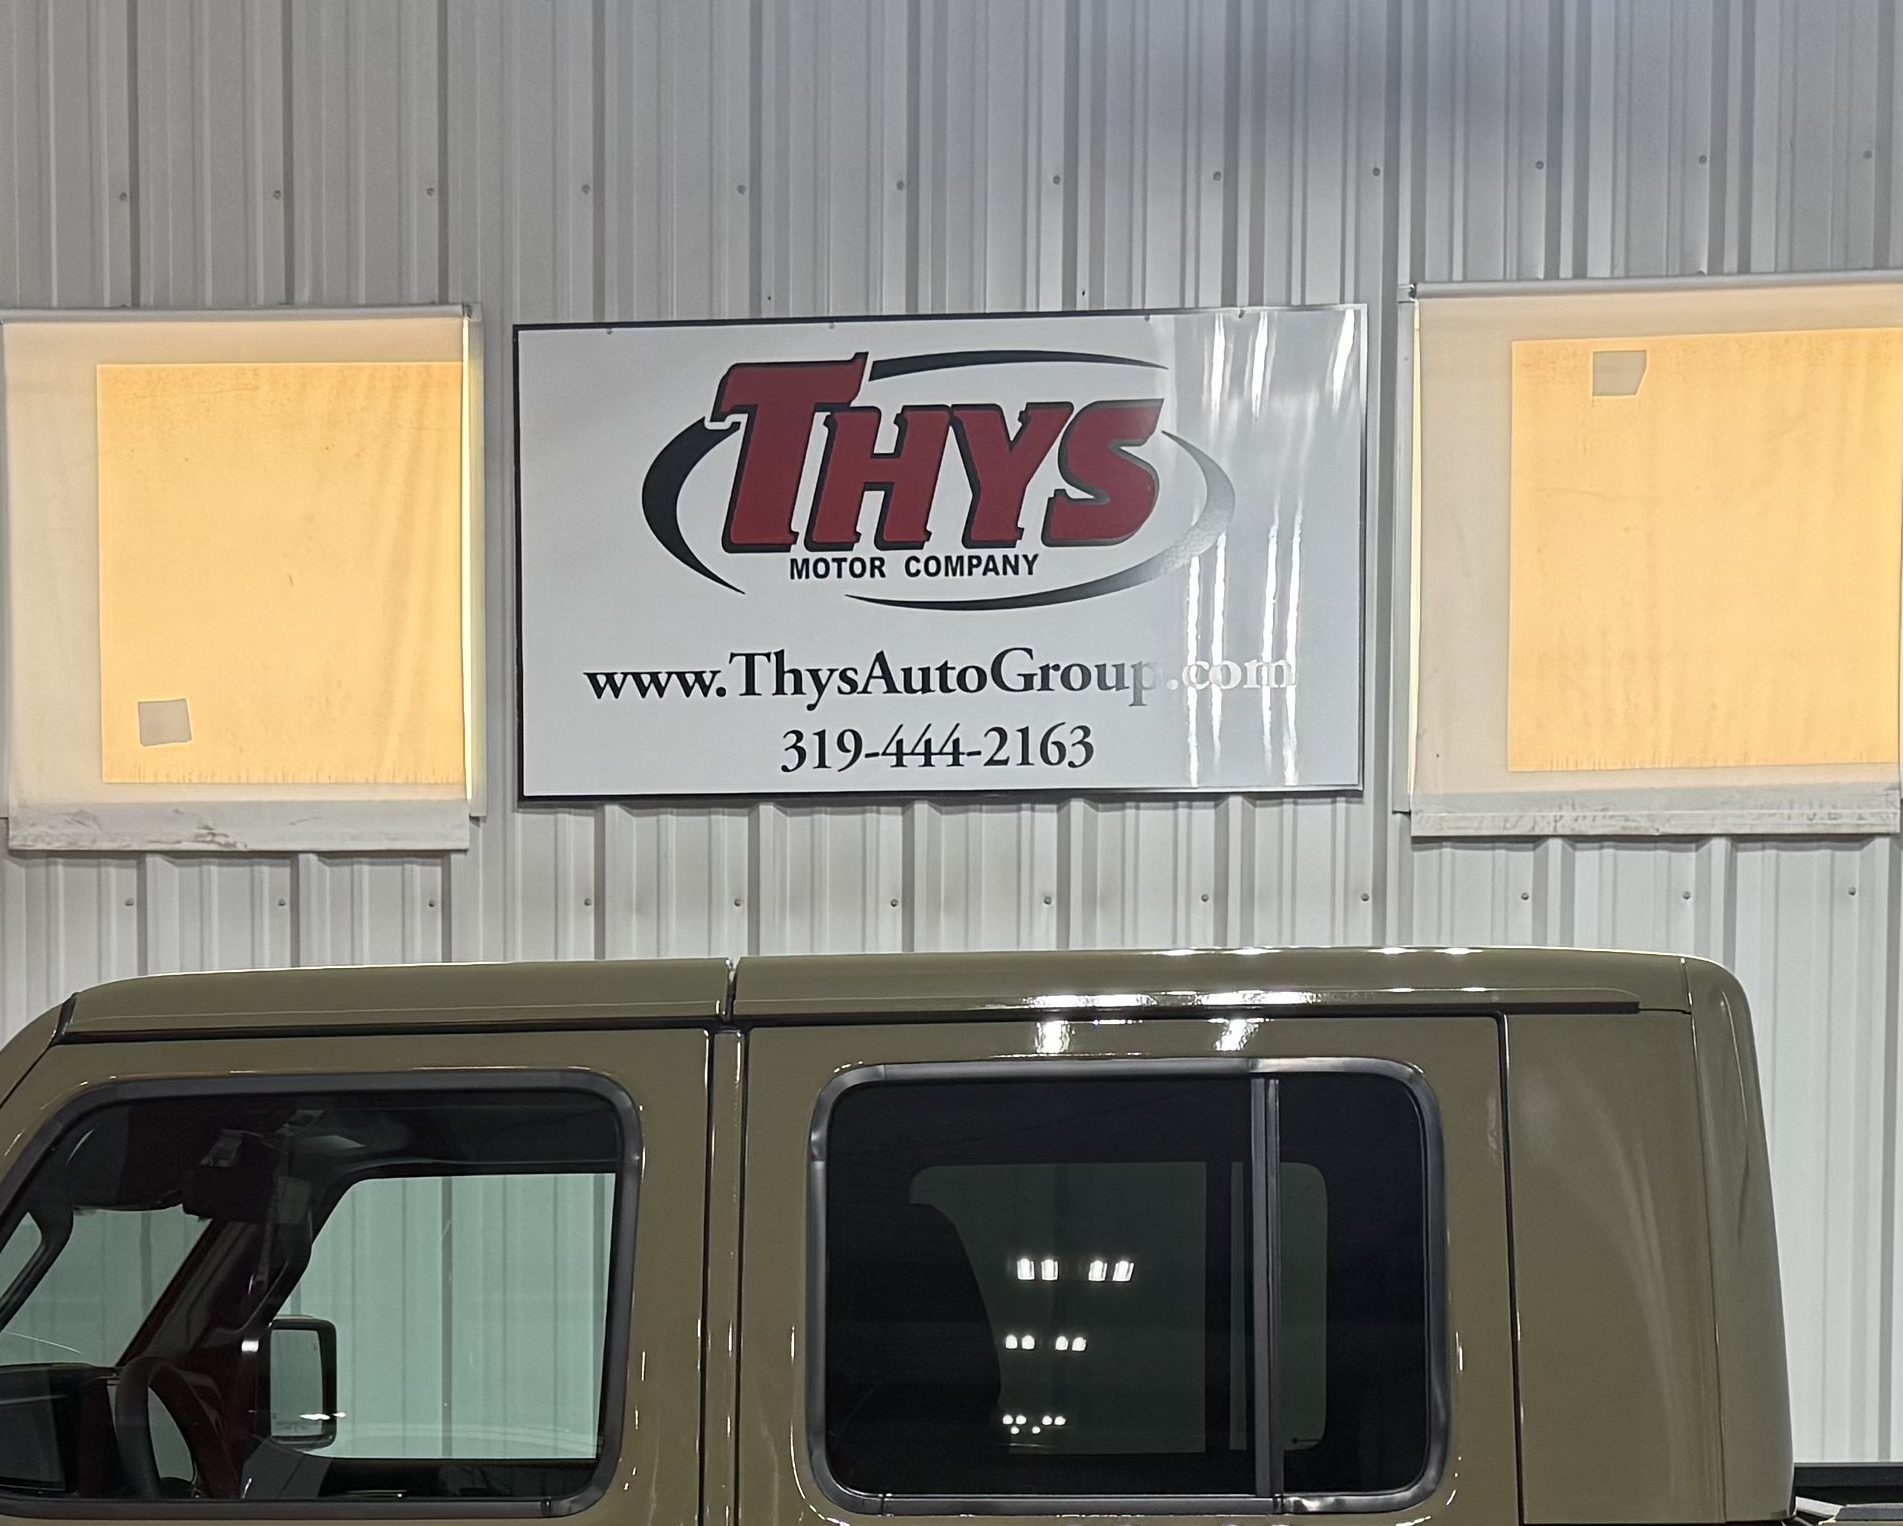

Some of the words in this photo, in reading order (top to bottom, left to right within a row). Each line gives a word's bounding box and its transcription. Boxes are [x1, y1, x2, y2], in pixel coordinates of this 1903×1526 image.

[712, 352, 1164, 554] THYS
[790, 556, 887, 580] MOTOR
[904, 553, 1040, 578] COMPANY
[583, 646, 1298, 716] www.ThysAutoGroup.com
[780, 721, 1095, 774] 319-444-2163
